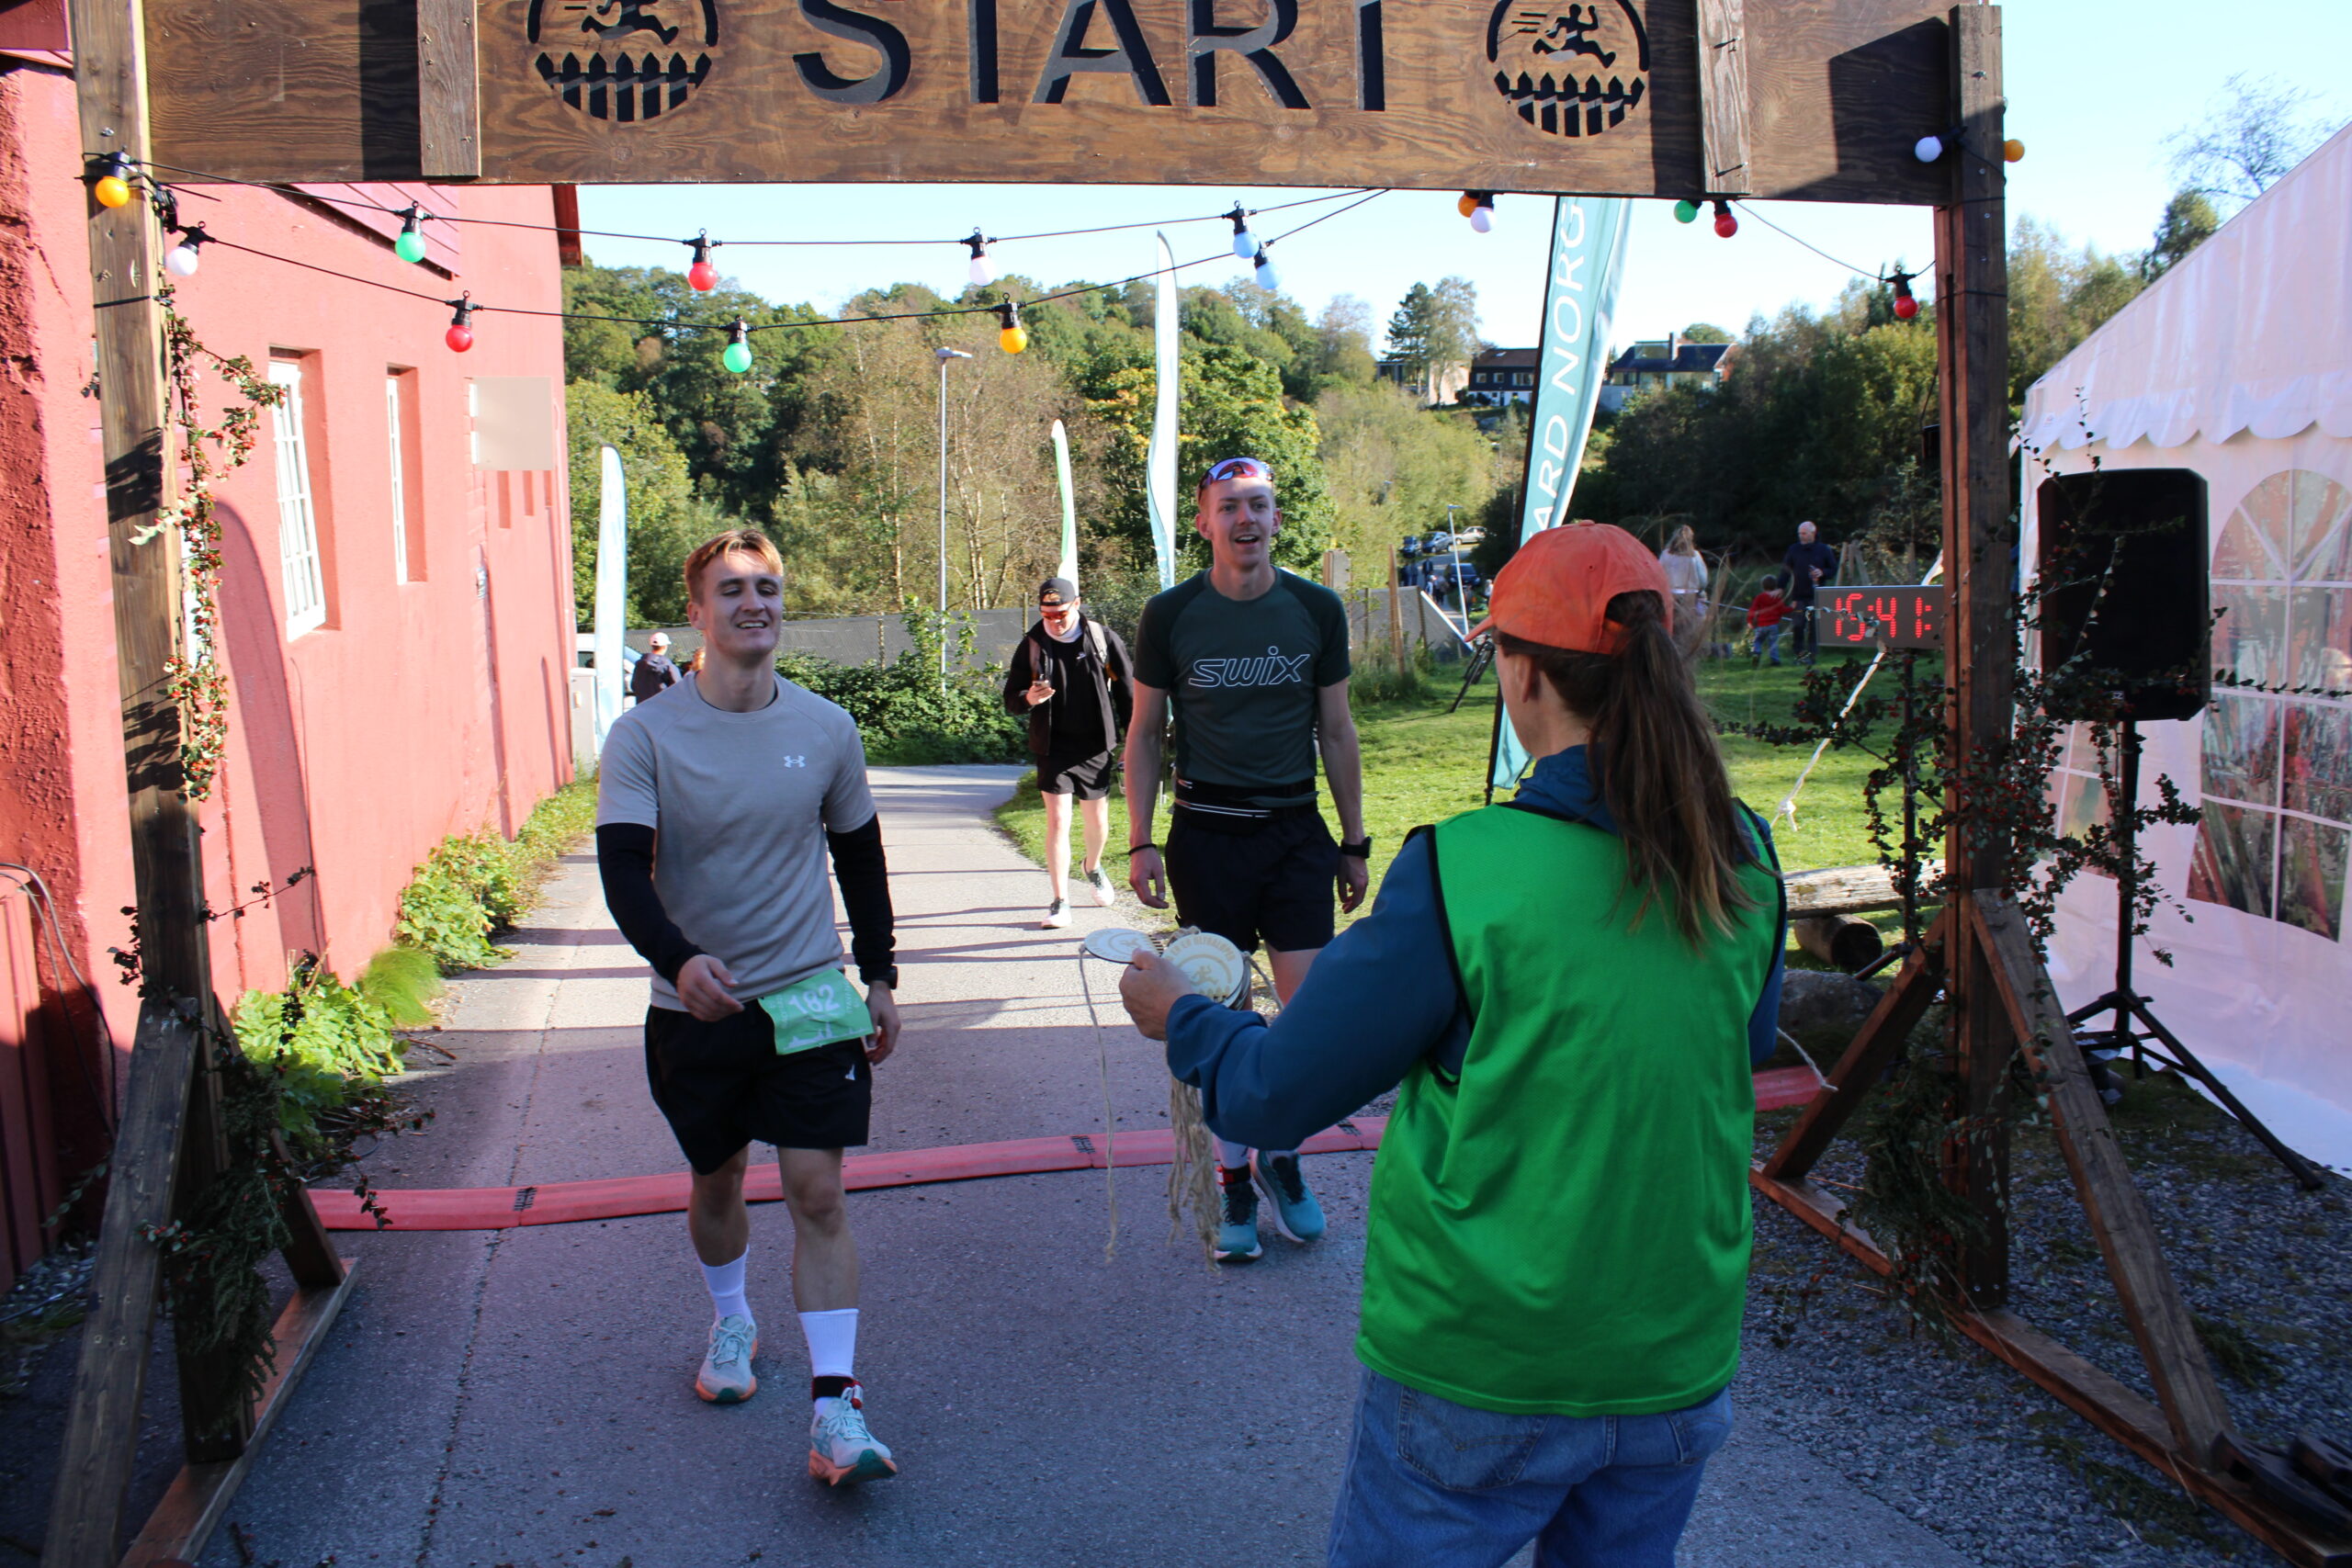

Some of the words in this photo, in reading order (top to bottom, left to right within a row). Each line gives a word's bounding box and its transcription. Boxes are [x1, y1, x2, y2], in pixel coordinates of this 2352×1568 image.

[1529, 414, 1567, 539] ARD
[1551, 202, 1585, 396] NORG
[788, 984, 841, 1015] 182
